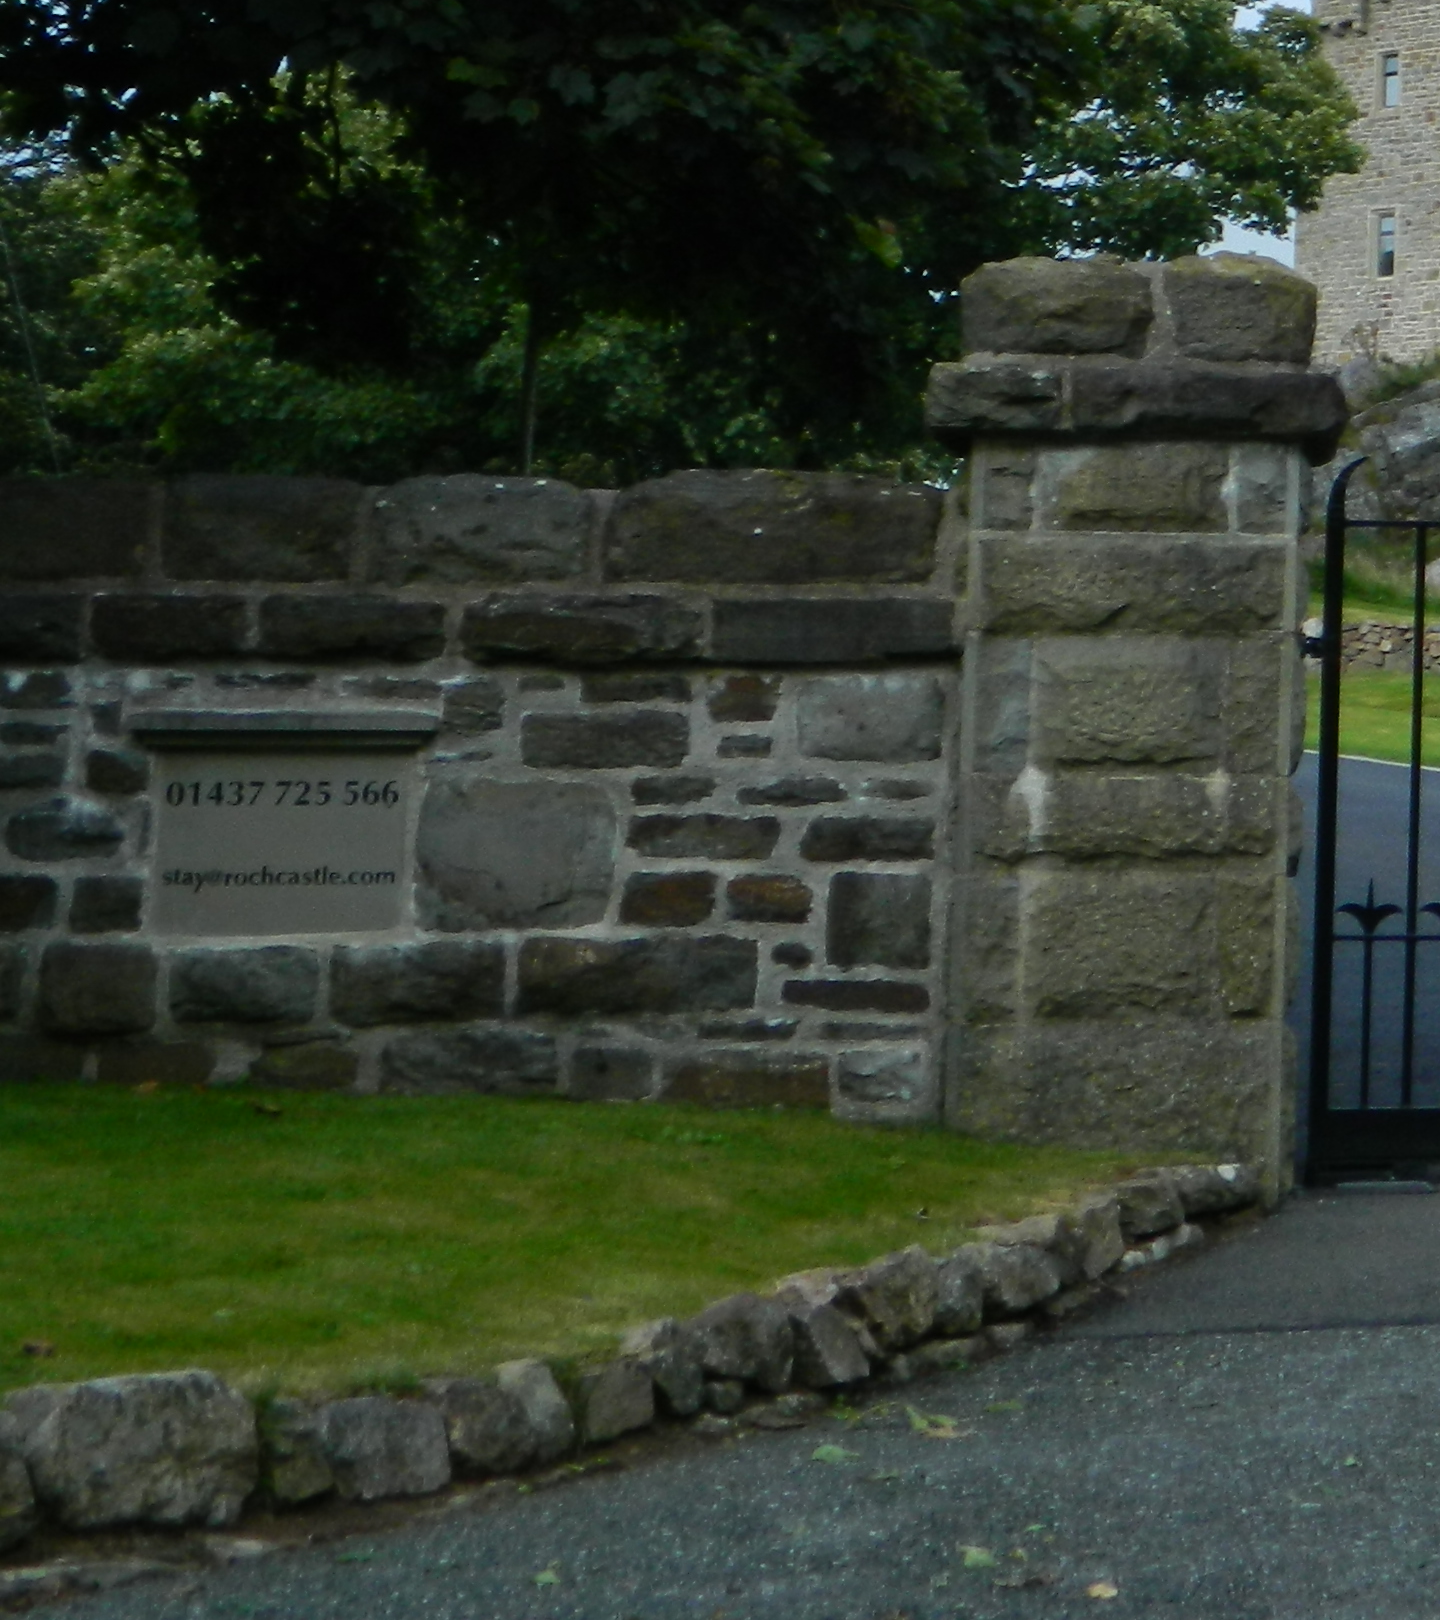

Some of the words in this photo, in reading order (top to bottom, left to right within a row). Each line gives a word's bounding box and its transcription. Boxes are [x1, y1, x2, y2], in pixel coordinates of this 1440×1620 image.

[165, 780, 265, 807] 01437
[274, 780, 332, 806] 725
[343, 780, 400, 809] 566
[161, 865, 397, 893] stay@rochcastle.com
